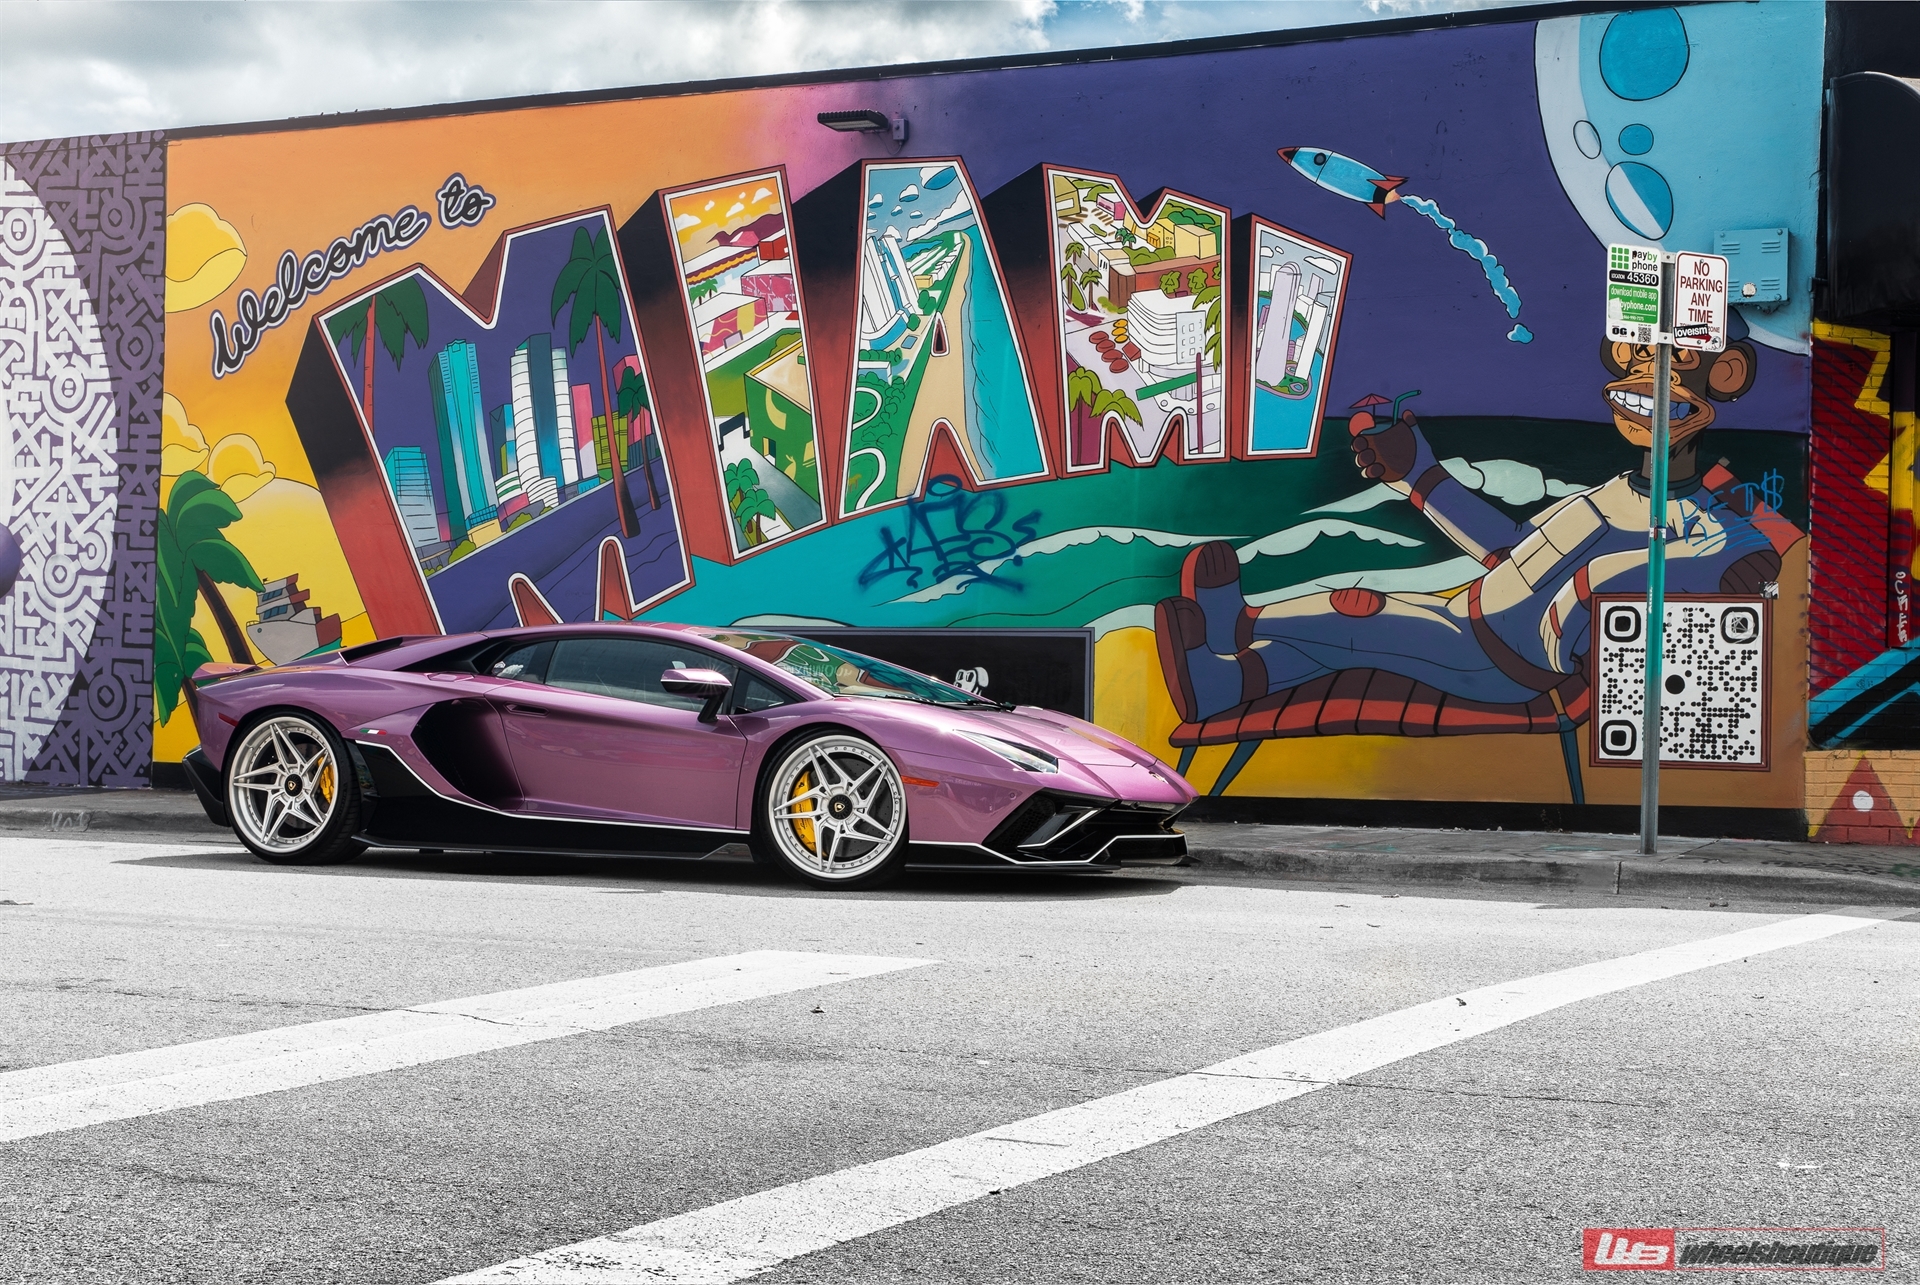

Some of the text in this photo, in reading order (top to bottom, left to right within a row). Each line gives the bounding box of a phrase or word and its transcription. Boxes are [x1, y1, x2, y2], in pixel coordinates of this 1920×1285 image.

[1632, 250, 1658, 263] payby
[1632, 260, 1658, 271] phone
[1693, 261, 1710, 277] NO
[210, 172, 496, 380] Welcome to
[1627, 272, 1657, 285] 45360
[1680, 276, 1722, 293] PARKING
[1611, 286, 1657, 301] download mobile app
[1691, 292, 1711, 307] ANY
[1619, 299, 1657, 312] byphone.com
[1688, 308, 1713, 324] TIME
[1674, 325, 1708, 338] loveism
[290, 155, 1354, 640] MIAMI
